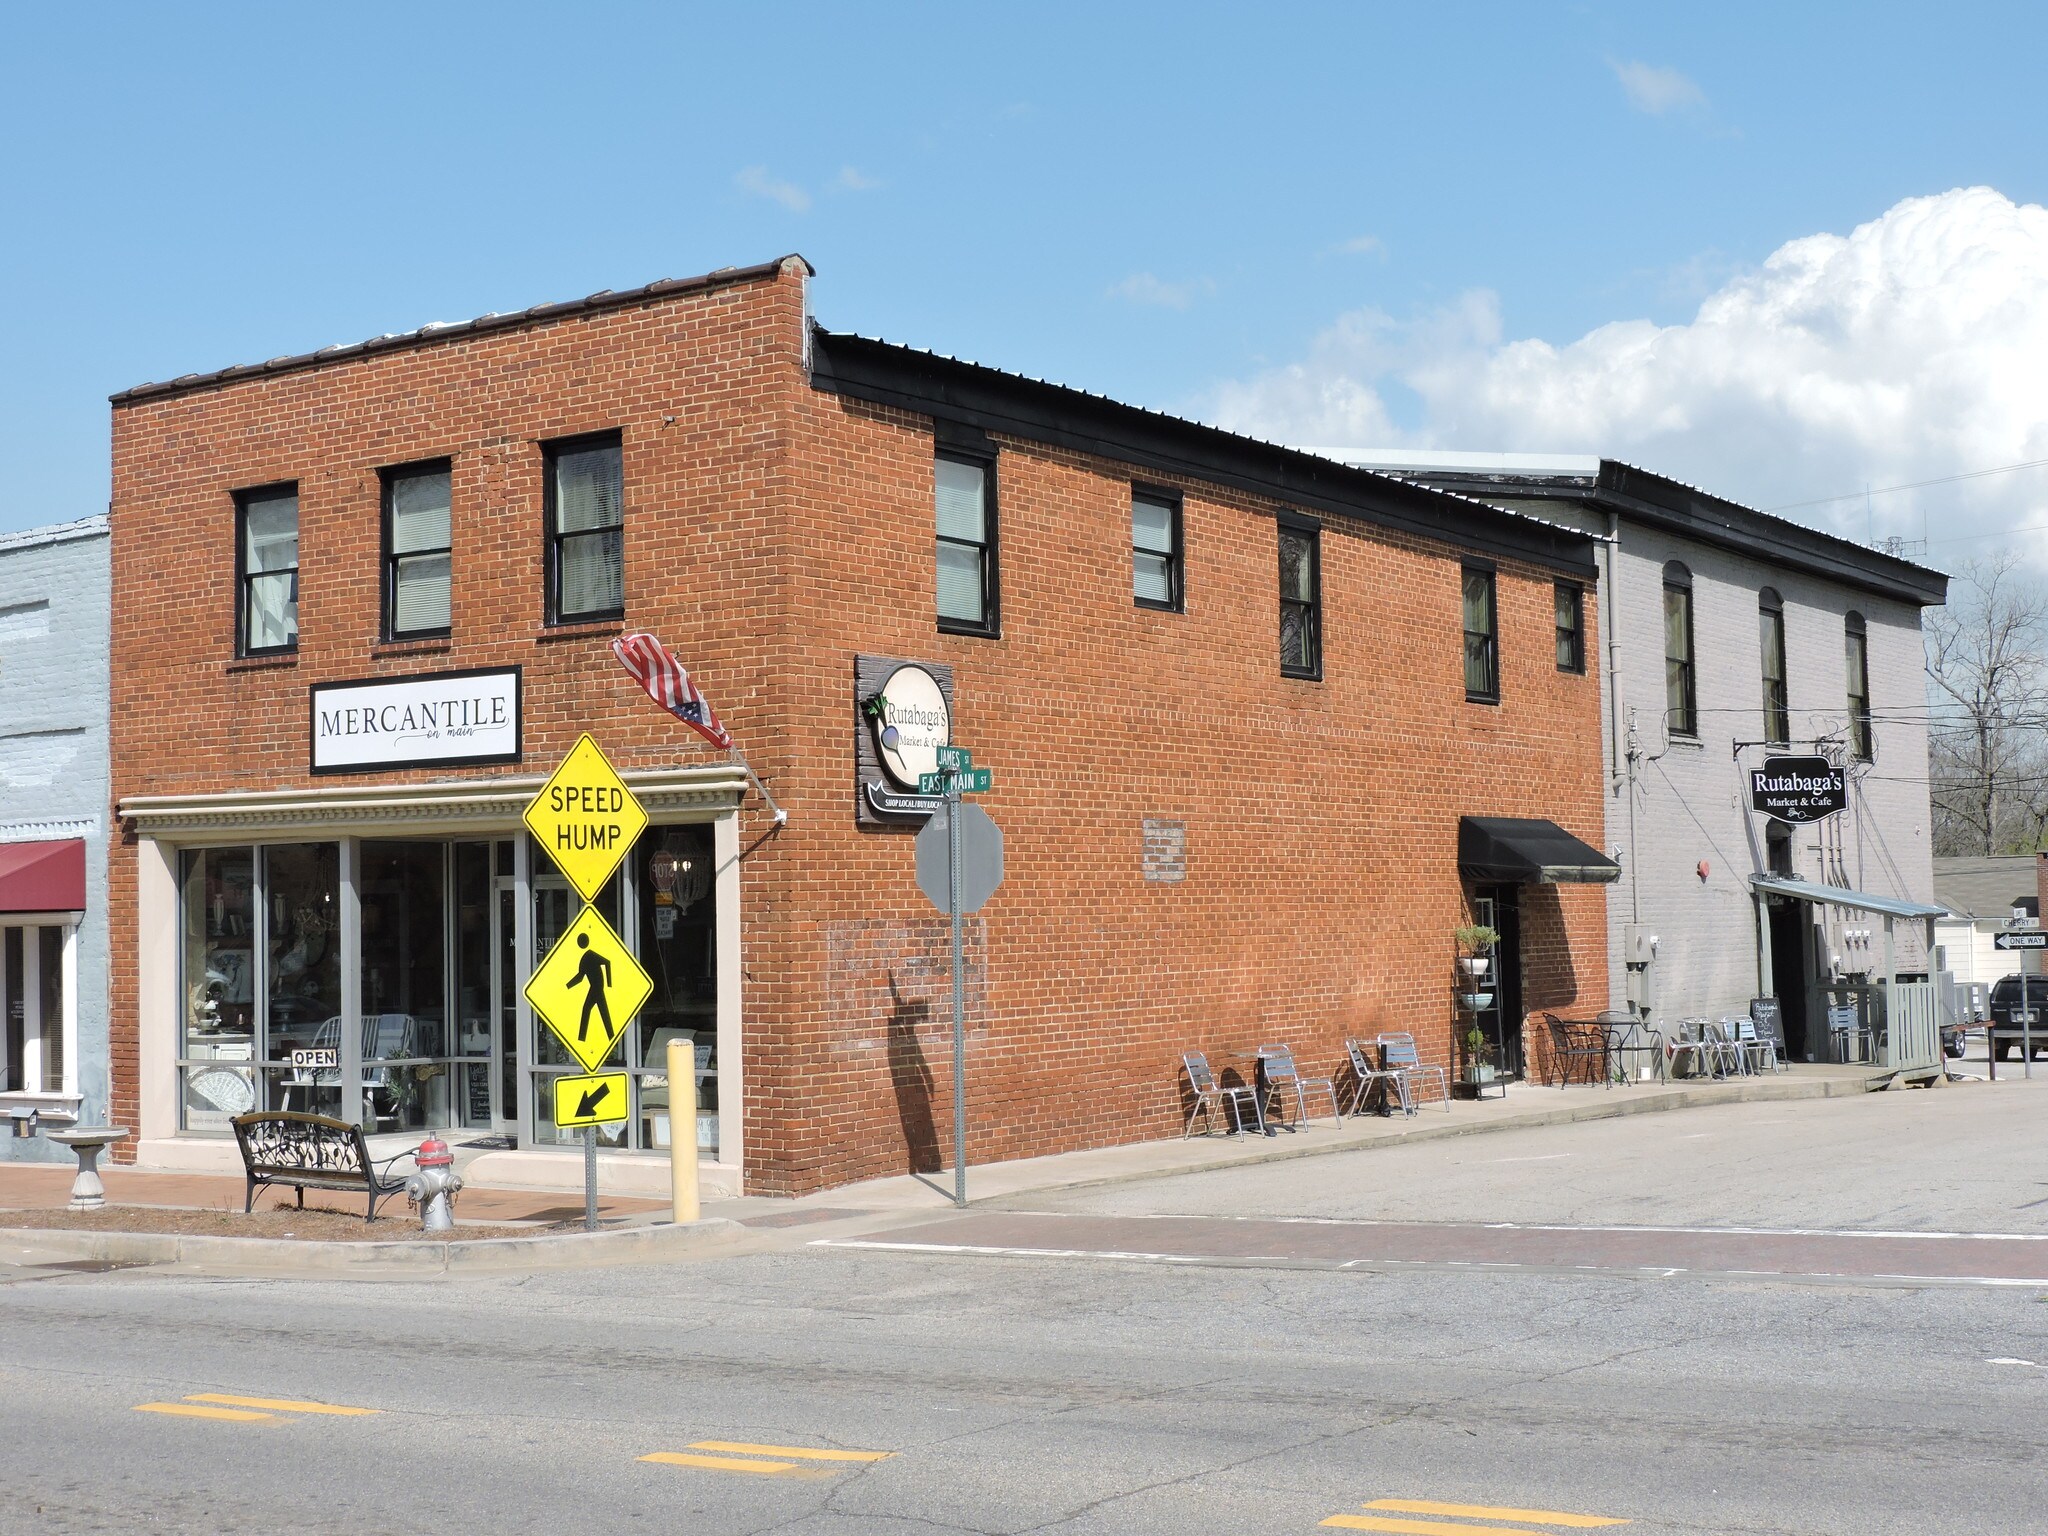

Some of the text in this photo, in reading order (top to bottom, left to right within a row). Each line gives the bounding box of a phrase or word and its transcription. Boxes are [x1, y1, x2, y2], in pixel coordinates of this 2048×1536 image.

[320, 696, 507, 737] MERCANTILE
[888, 702, 946, 731] Rutabaga's
[446, 725, 475, 738] main
[899, 734, 922, 747] Market
[923, 737, 930, 748] &
[938, 749, 969, 767] JAMES ST
[921, 773, 987, 793] EAST MAIN ST
[1754, 772, 1842, 796] Rutabaga's
[550, 786, 623, 813] SPEED
[885, 799, 898, 807] SHOP
[1767, 797, 1832, 807] Market & Cafe
[557, 824, 621, 850] HUMP
[2003, 919, 2030, 927] CHERRY
[2009, 937, 2026, 945] ONE
[294, 1051, 335, 1064] OPEN
